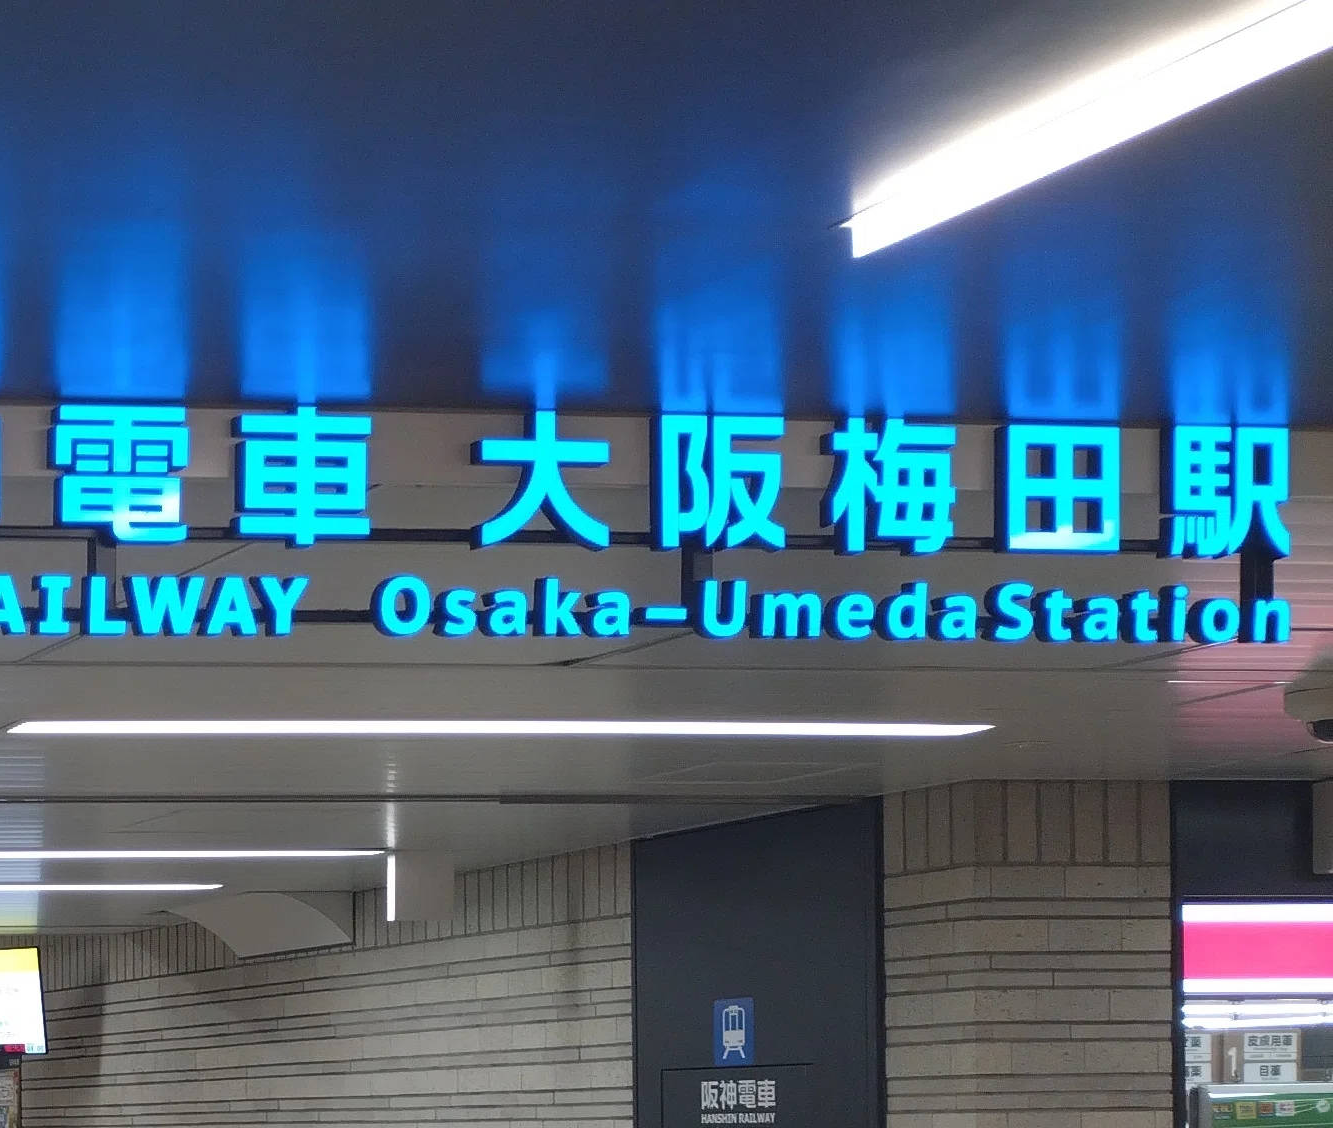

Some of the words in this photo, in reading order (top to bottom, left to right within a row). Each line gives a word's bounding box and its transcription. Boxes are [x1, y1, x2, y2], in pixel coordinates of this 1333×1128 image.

[476, 409, 1291, 559] 大阪梅田駅
[700, 1079, 777, 1111] 阪神電車
[700, 1113, 737, 1124] HANSHIN
[738, 1112, 776, 1123] RAILWAY
